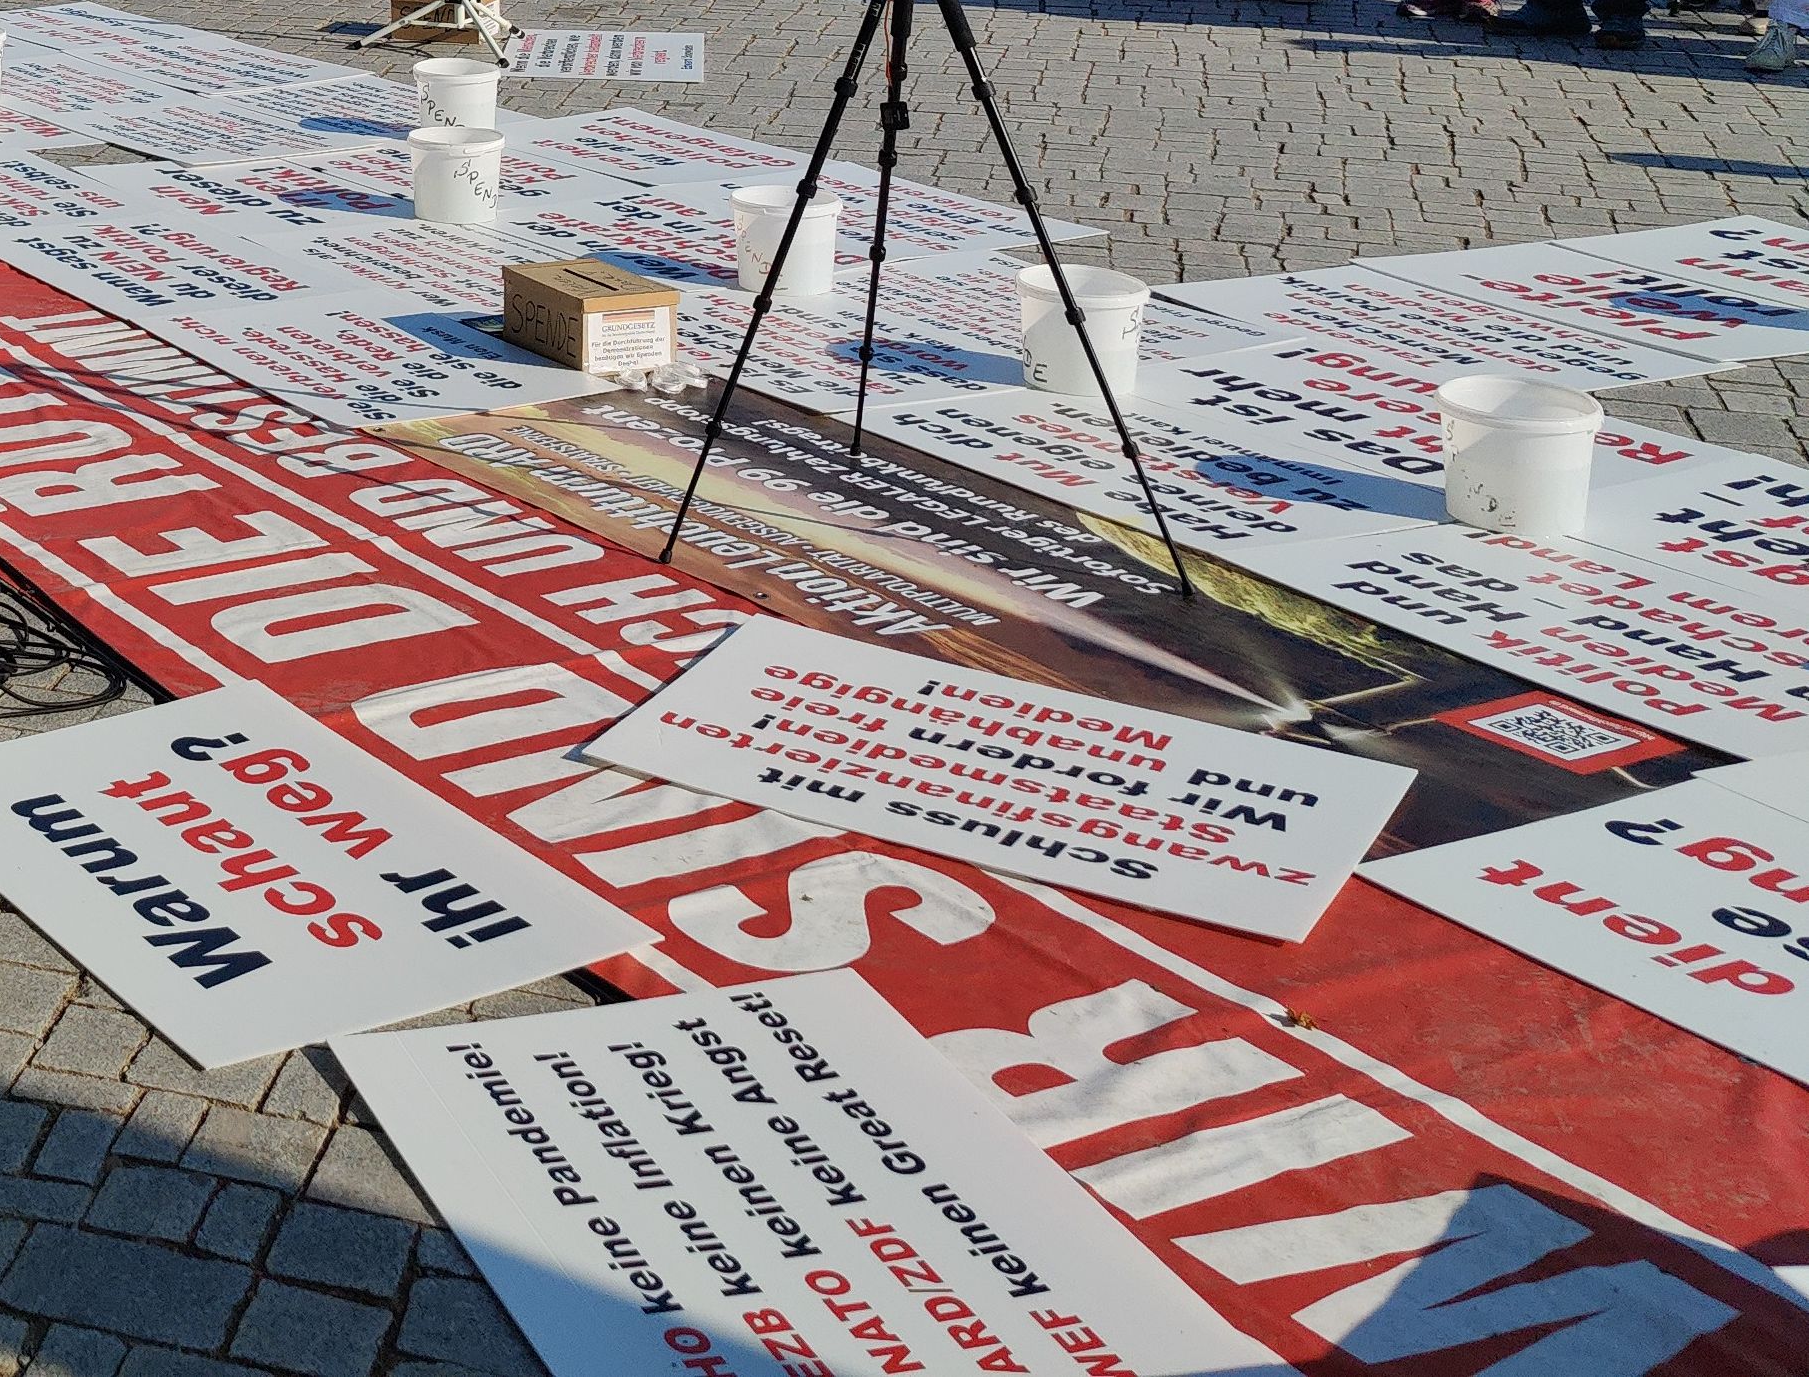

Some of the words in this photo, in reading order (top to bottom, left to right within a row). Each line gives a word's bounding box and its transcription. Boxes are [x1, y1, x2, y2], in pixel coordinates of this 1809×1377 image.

[533, 140, 654, 170] Freiheit
[575, 138, 635, 152] alle
[580, 125, 759, 168] politischen
[597, 117, 796, 166] Gefangenen!
[633, 154, 685, 165] für
[74, 192, 125, 208] uns
[148, 186, 238, 215] Nein
[155, 169, 272, 206] dieser
[235, 177, 337, 208] irren
[250, 167, 401, 212] Politik!
[621, 194, 707, 216] auf!
[53, 202, 98, 217] Sie
[266, 210, 326, 225] zu
[509, 222, 577, 237] der
[594, 201, 662, 219] der
[663, 221, 706, 233] in
[14, 238, 98, 269] sagst
[63, 236, 106, 249] zu
[130, 224, 310, 291] Regierung?!
[537, 213, 739, 281] Demokratie
[577, 241, 621, 255] in
[88, 251, 176, 281] NEIN
[177, 266, 278, 300] dieser
[614, 255, 699, 279] Wer
[91, 272, 176, 306] Wann
[168, 283, 216, 298] du
[1278, 276, 1395, 311] Politik
[1343, 285, 1479, 322] Medien
[1461, 275, 1720, 340] Pleite-
[1533, 274, 1764, 328] welle
[1586, 270, 1806, 320] rollt!
[169, 317, 237, 345] nicht
[325, 311, 439, 352] hassen!
[511, 294, 579, 358] SPENDE
[601, 321, 656, 333] GRUNDGESETZ
[699, 325, 753, 340] als
[760, 305, 847, 328] sind.
[1286, 293, 1561, 372] demonstrieren
[1291, 308, 1484, 364] Menschen
[1400, 314, 1518, 342] diese
[1416, 290, 1627, 350] schweigen.
[1484, 325, 1547, 341] die
[242, 328, 359, 382] Hassrede.
[276, 327, 391, 377] verbieten
[336, 330, 406, 361] Rede,
[429, 351, 475, 369] sie
[1263, 313, 1440, 367] Tausende
[1547, 345, 1633, 365] und
[232, 348, 355, 399] verbieten
[402, 363, 449, 379] die
[473, 372, 522, 388] die
[1512, 346, 1648, 380] gegen
[347, 399, 396, 420] Sie
[355, 385, 403, 403] die
[391, 379, 440, 397] Sie
[1180, 369, 1370, 422] mehr
[893, 414, 993, 448] dich
[1188, 395, 1295, 425] ist
[430, 431, 558, 469] ARD
[571, 403, 759, 466] Prozent
[936, 409, 1115, 469] eigenen
[1051, 403, 1297, 488] bedienen.
[1304, 429, 1445, 474] Das
[730, 465, 820, 490] 99
[992, 453, 1098, 486] Mut
[509, 465, 794, 569] Leuchtturm
[793, 490, 901, 521] die
[1104, 491, 1253, 539] Habe
[1122, 470, 1297, 532] deines
[1290, 488, 1372, 510] zu
[349, 479, 604, 577] UND
[869, 519, 1016, 566] sind
[1463, 528, 1656, 590] Land!
[77, 511, 480, 663] DIE
[738, 563, 959, 639] Aktion
[985, 564, 1119, 606] Wir
[1331, 581, 1467, 624] und
[1346, 561, 1530, 622] Hand
[1476, 630, 1711, 716] Politik
[1541, 627, 1807, 722] Medien
[751, 688, 887, 731] freie
[765, 666, 1166, 771] unabhängige
[917, 681, 1172, 749] Medien!
[752, 718, 1235, 842] Staatsmedien!
[909, 727, 1149, 795] fordern
[170, 731, 394, 860] weg?
[660, 712, 1316, 884] zwangsfinanzierten
[758, 769, 865, 801] mit
[1187, 769, 1318, 807] und
[351, 662, 996, 988] SIND
[1169, 793, 1286, 829] Wir
[97, 769, 382, 948] schaut
[886, 802, 1158, 878] Schluss
[11, 793, 272, 989] Warum
[381, 867, 531, 948] ihr
[1477, 860, 1795, 995] dient
[673, 1018, 775, 1103] Angst
[608, 1042, 712, 1135] Krieg!
[768, 1116, 865, 1206] keine
[928, 979, 1737, 1377] WIR
[705, 1145, 820, 1258] keinen
[847, 1219, 1026, 1372] ARD/ZDF
[805, 1270, 923, 1374] NATO
